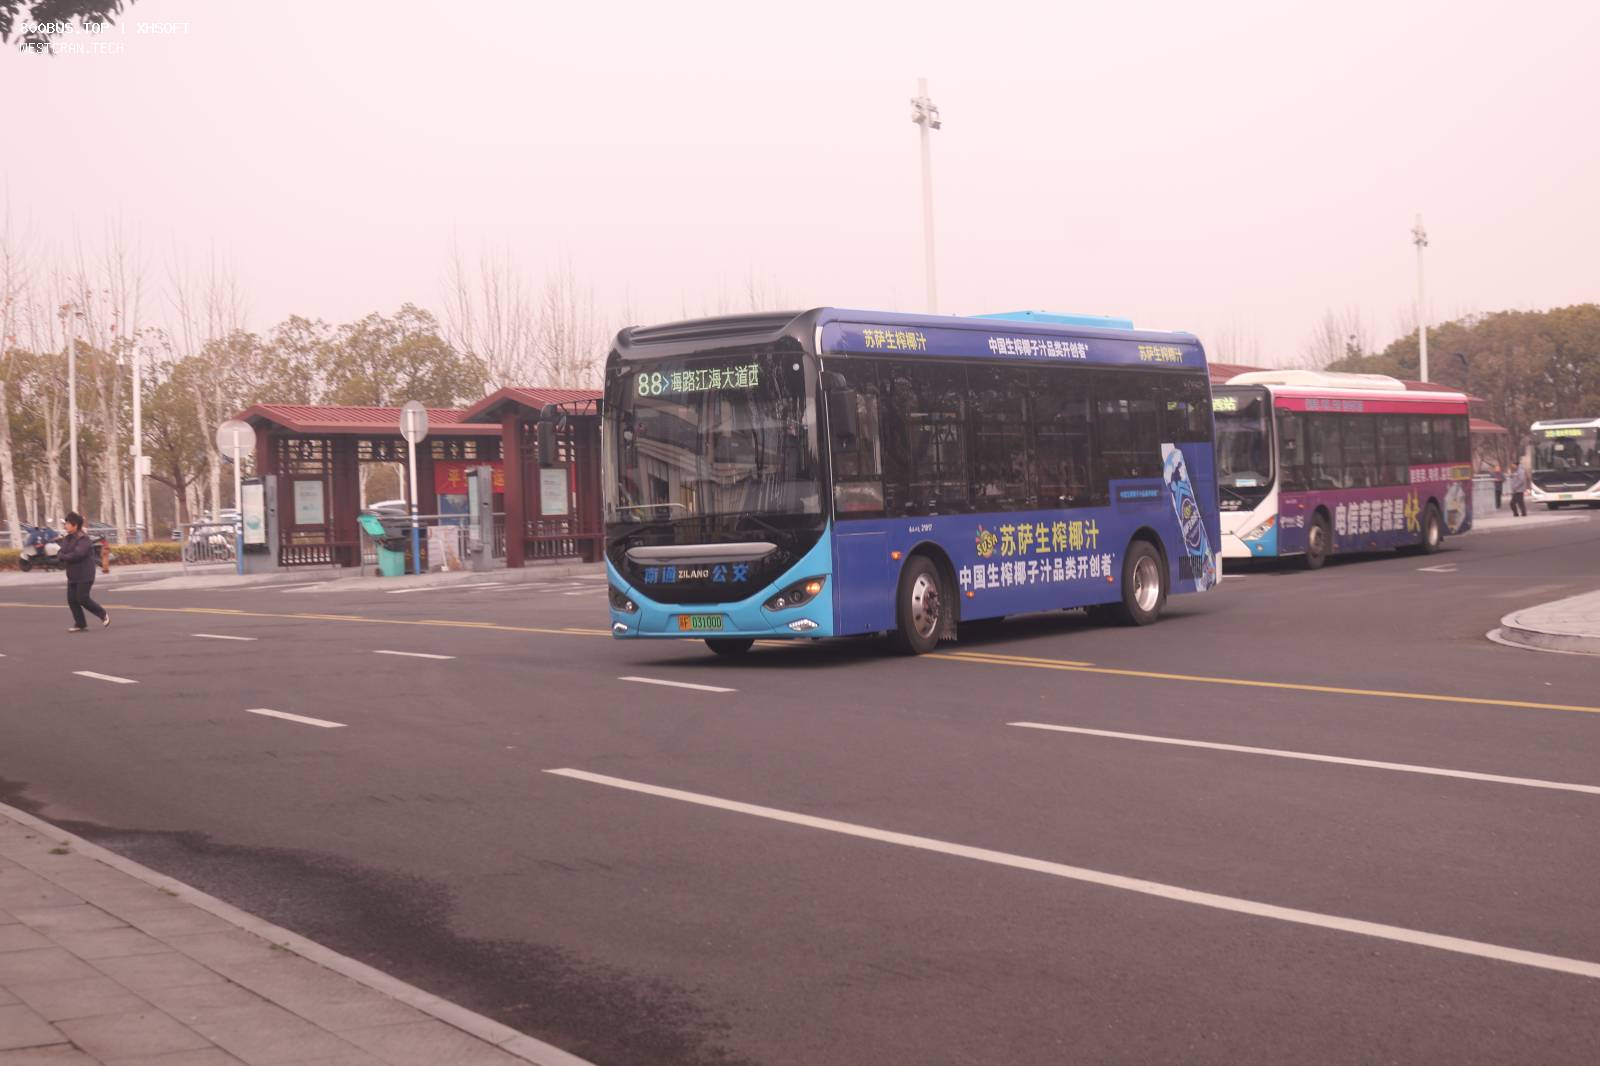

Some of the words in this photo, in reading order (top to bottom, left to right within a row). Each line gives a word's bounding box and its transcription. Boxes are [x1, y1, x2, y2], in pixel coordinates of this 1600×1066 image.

[863, 329, 927, 351] 苏萨生榨椰汁
[638, 372, 662, 396] 88
[1000, 519, 1099, 556] 苏萨生榨椰汁
[678, 569, 709, 579] ZILANG
